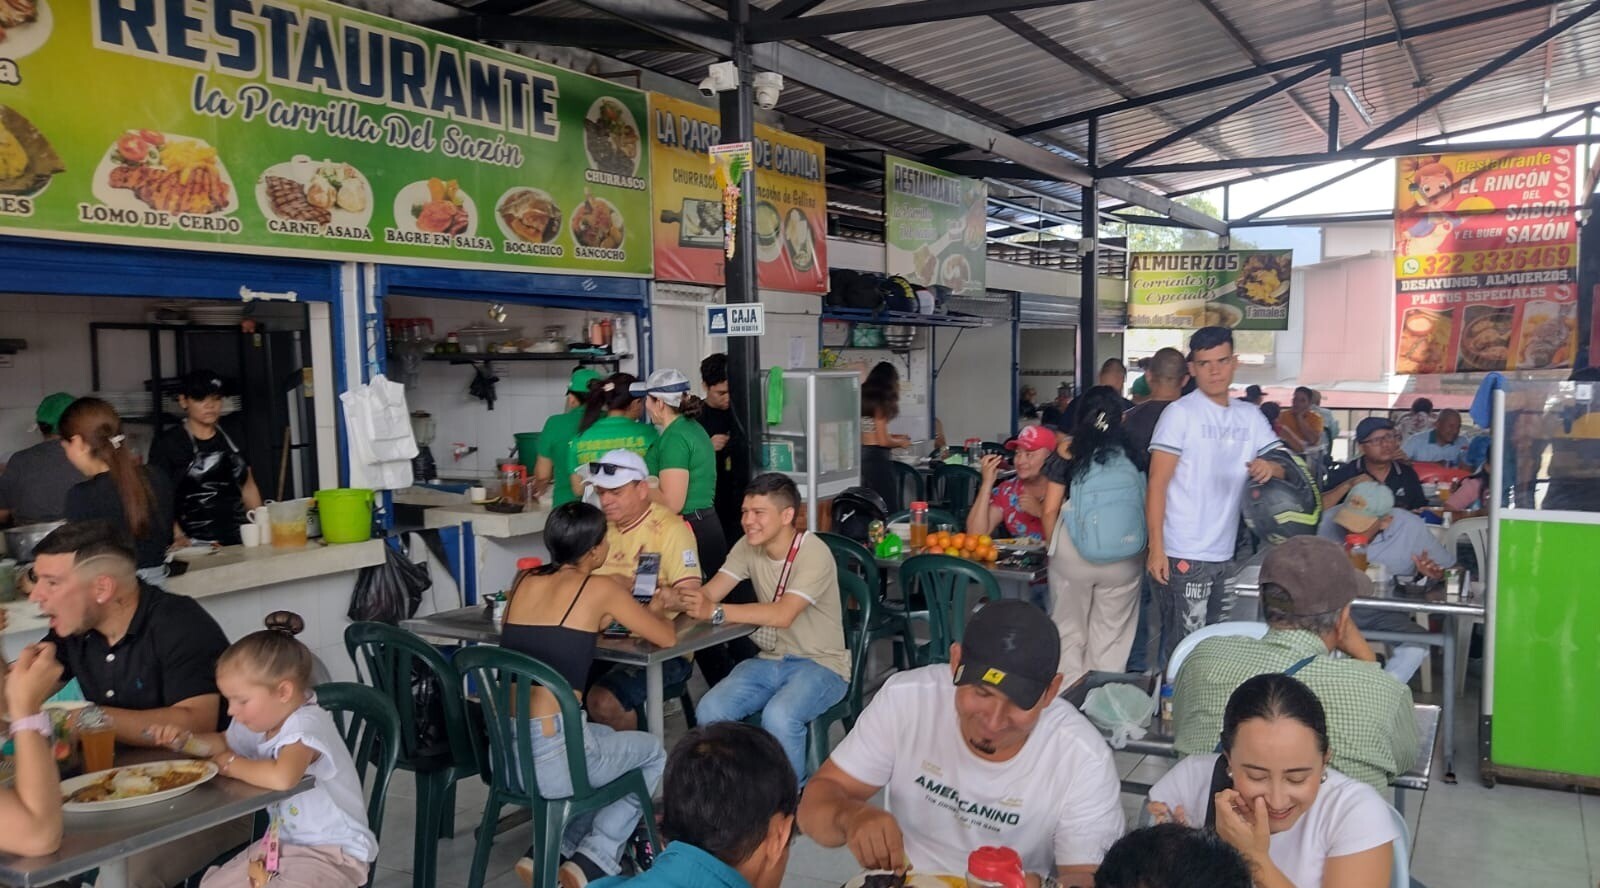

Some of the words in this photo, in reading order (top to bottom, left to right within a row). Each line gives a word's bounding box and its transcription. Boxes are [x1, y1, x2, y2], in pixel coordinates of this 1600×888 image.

[95, 0, 559, 140] RESTAURANTE
[239, 86, 380, 142] Parrilla
[383, 115, 434, 150] Del
[443, 127, 522, 166] Sazón
[656, 109, 678, 145] LA
[680, 116, 722, 151] PARR
[754, 137, 772, 167] DE
[775, 144, 821, 181] CAMILA
[1456, 152, 1551, 173] Restaurante
[585, 169, 646, 190] CHURRASCO
[673, 168, 718, 190] CHURRASCO
[895, 165, 960, 207] RESTAURANTE
[1459, 178, 1479, 194] EL
[1484, 169, 1550, 193] RINCÓN
[1522, 191, 1541, 199] DEL
[81, 206, 139, 225] LOMO
[144, 213, 169, 226] DE
[180, 214, 240, 232] CERDO
[1506, 200, 1569, 221] SABOR
[269, 220, 319, 235] CARNE
[325, 226, 371, 240] ASADA
[386, 230, 431, 245] BAGRE
[434, 234, 450, 246] EN
[456, 236, 493, 250] SALSA
[1462, 230, 1473, 239] EL
[1475, 228, 1503, 239] BUEN
[1505, 220, 1569, 243] SAZÓN
[505, 242, 563, 256] BOCACHICO
[575, 247, 625, 260] SANCOCHO
[1131, 254, 1239, 271] ALMUERZOS
[1423, 255, 1464, 275] 322
[1472, 248, 1570, 273] 3336469
[1133, 275, 1202, 290] Corrientes
[1206, 275, 1217, 288] y
[1401, 276, 1481, 290] DESAYUNOS,
[1486, 270, 1571, 285] ALMUERZOS,
[1411, 292, 1462, 305] PLATOS
[1466, 288, 1547, 301] ESPECIALES
[731, 309, 757, 323] CAJA
[1246, 307, 1285, 318] Tamales
[914, 776, 1020, 826] AMERCANINO
